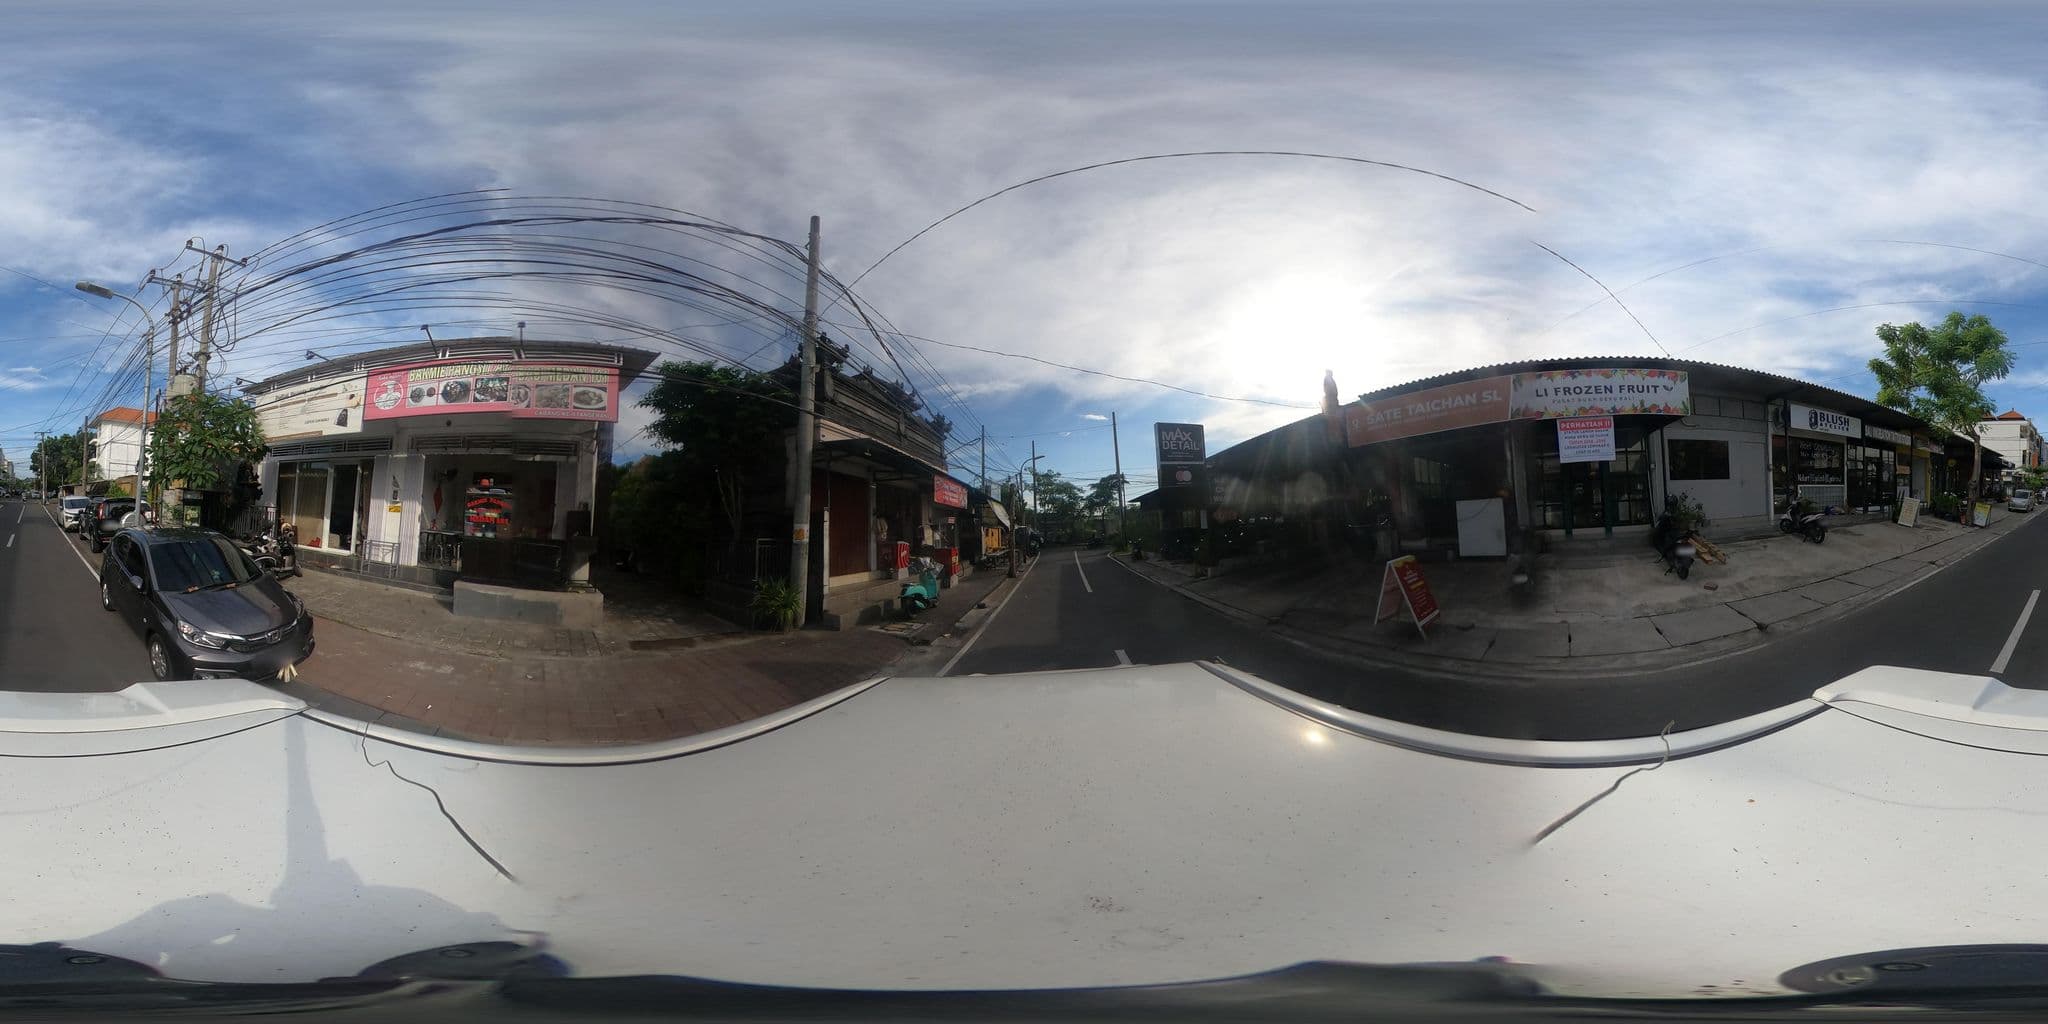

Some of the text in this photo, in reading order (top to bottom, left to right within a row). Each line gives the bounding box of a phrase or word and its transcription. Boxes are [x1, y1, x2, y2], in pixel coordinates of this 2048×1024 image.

[1536, 385, 1660, 397] LI FROZEN FRUIT
[1367, 409, 1401, 425] SATE
[1407, 394, 1477, 416] TAICHAN
[1819, 412, 1849, 427] BLUSH
[1162, 427, 1192, 441] MAX
